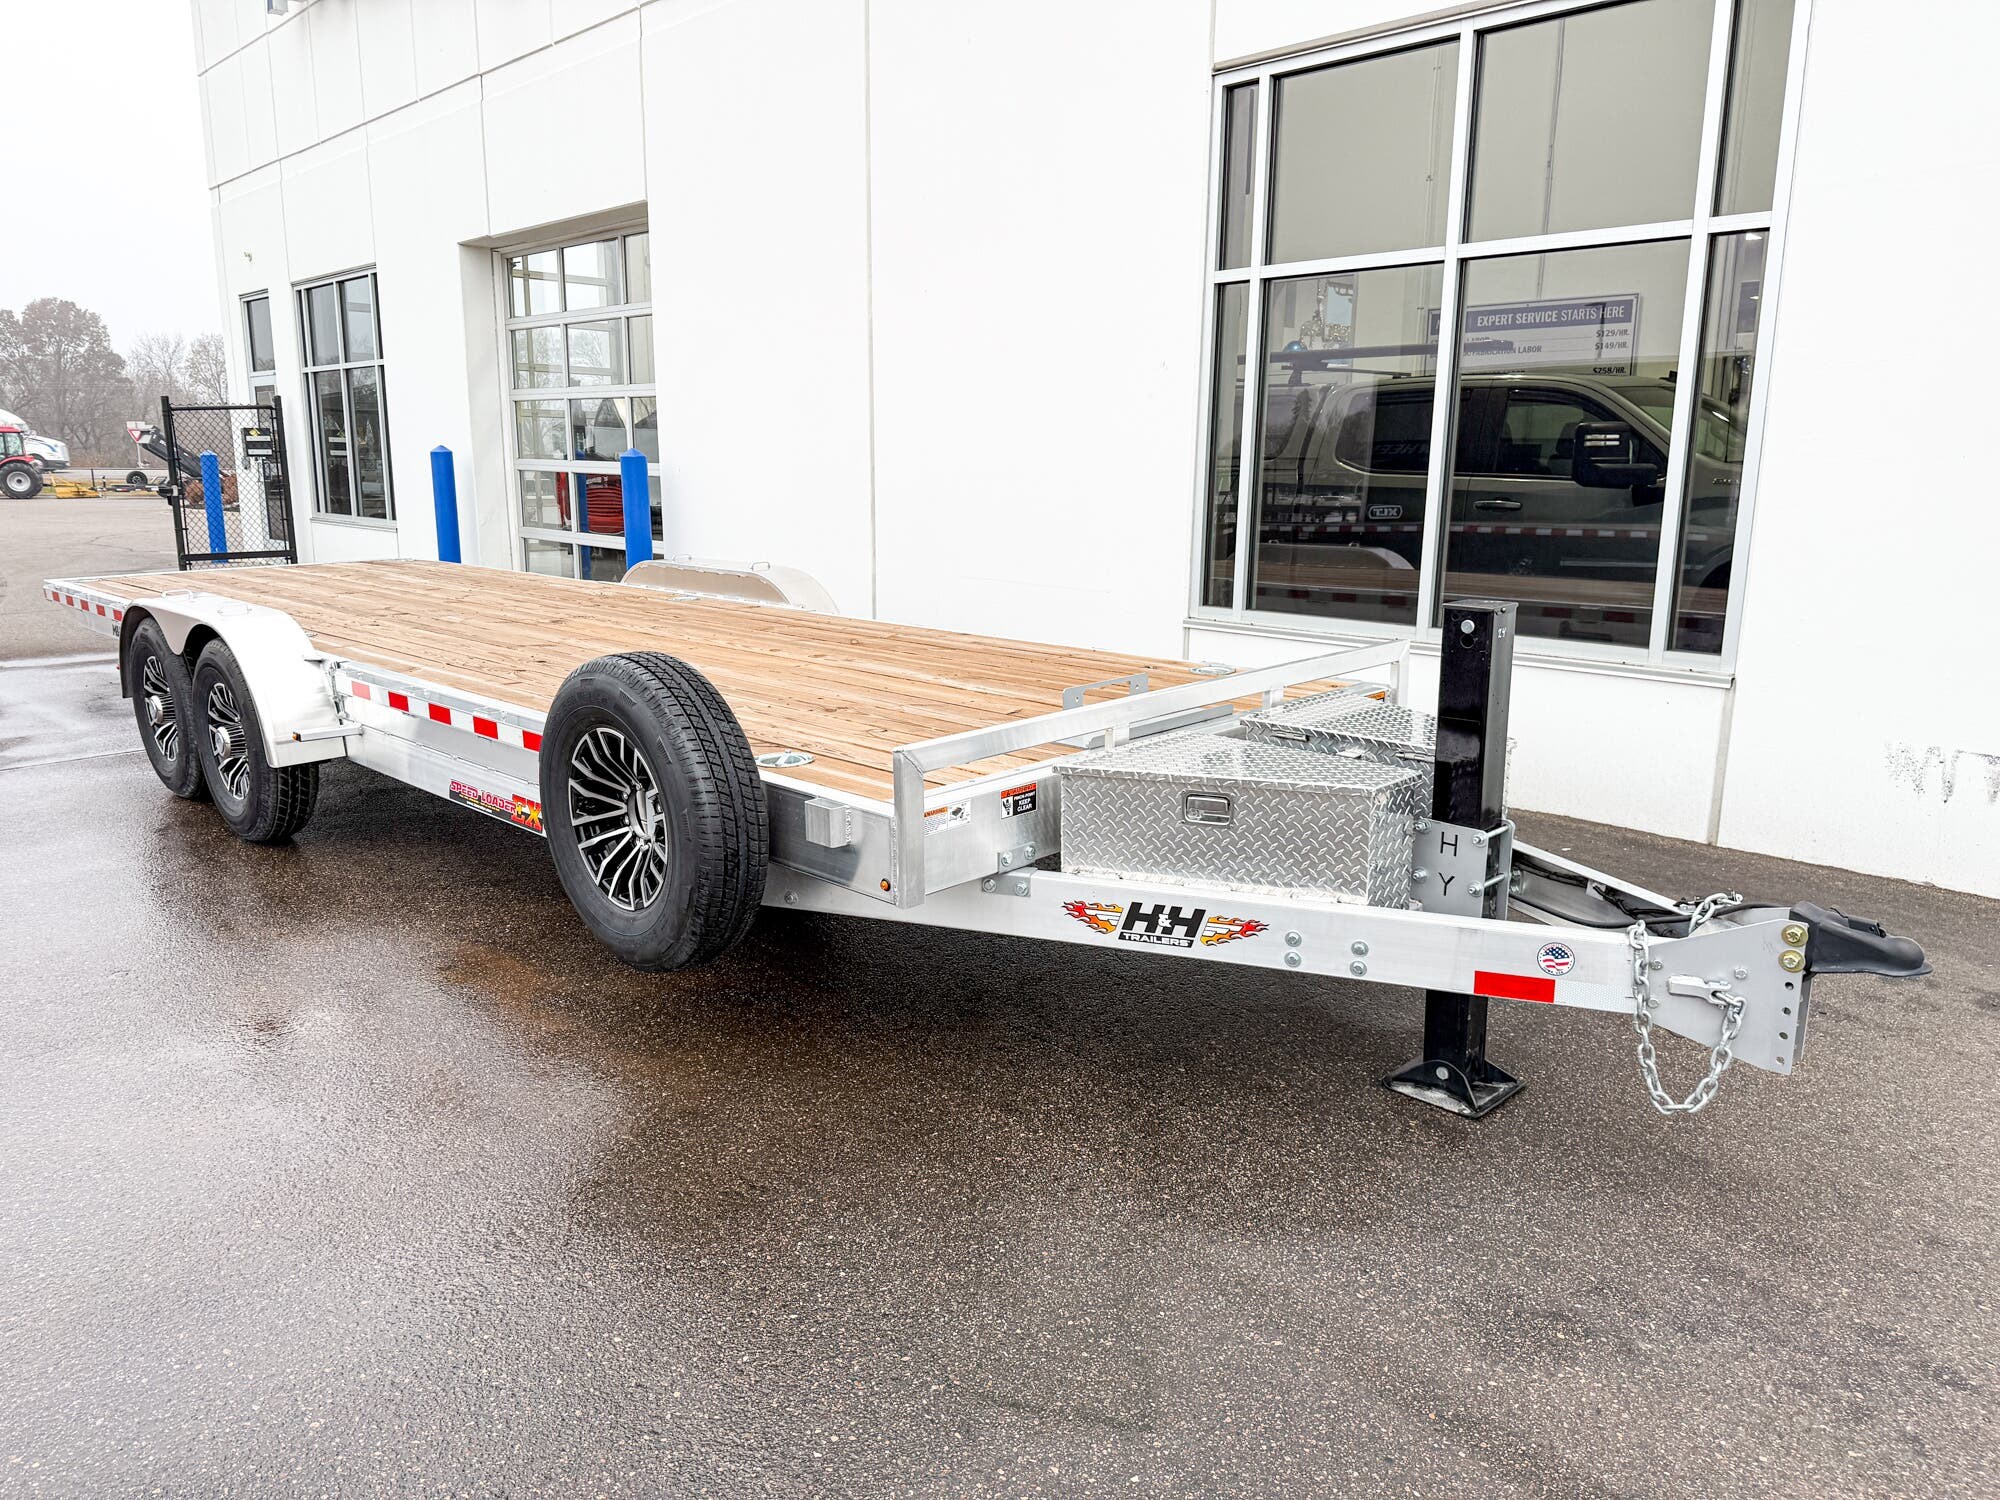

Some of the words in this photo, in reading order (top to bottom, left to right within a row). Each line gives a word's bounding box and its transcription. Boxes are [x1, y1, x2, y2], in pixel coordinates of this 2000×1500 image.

[1477, 313, 1513, 327] EXPERT
[1515, 310, 1558, 325] SERVICE
[1560, 307, 1597, 321] STARTS
[1600, 305, 1625, 319] HERE
[1518, 344, 1542, 354] LABOR
[450, 780, 478, 799] SPEED
[481, 791, 516, 814] LOADER
[511, 794, 542, 831] EX
[1016, 803, 1033, 812] CLEAR
[1018, 798, 1031, 806] KEEP
[1440, 831, 1458, 857] H
[1438, 872, 1455, 896] Y
[1121, 901, 1206, 938] H&H
[1123, 932, 1190, 947] TRAILERS
